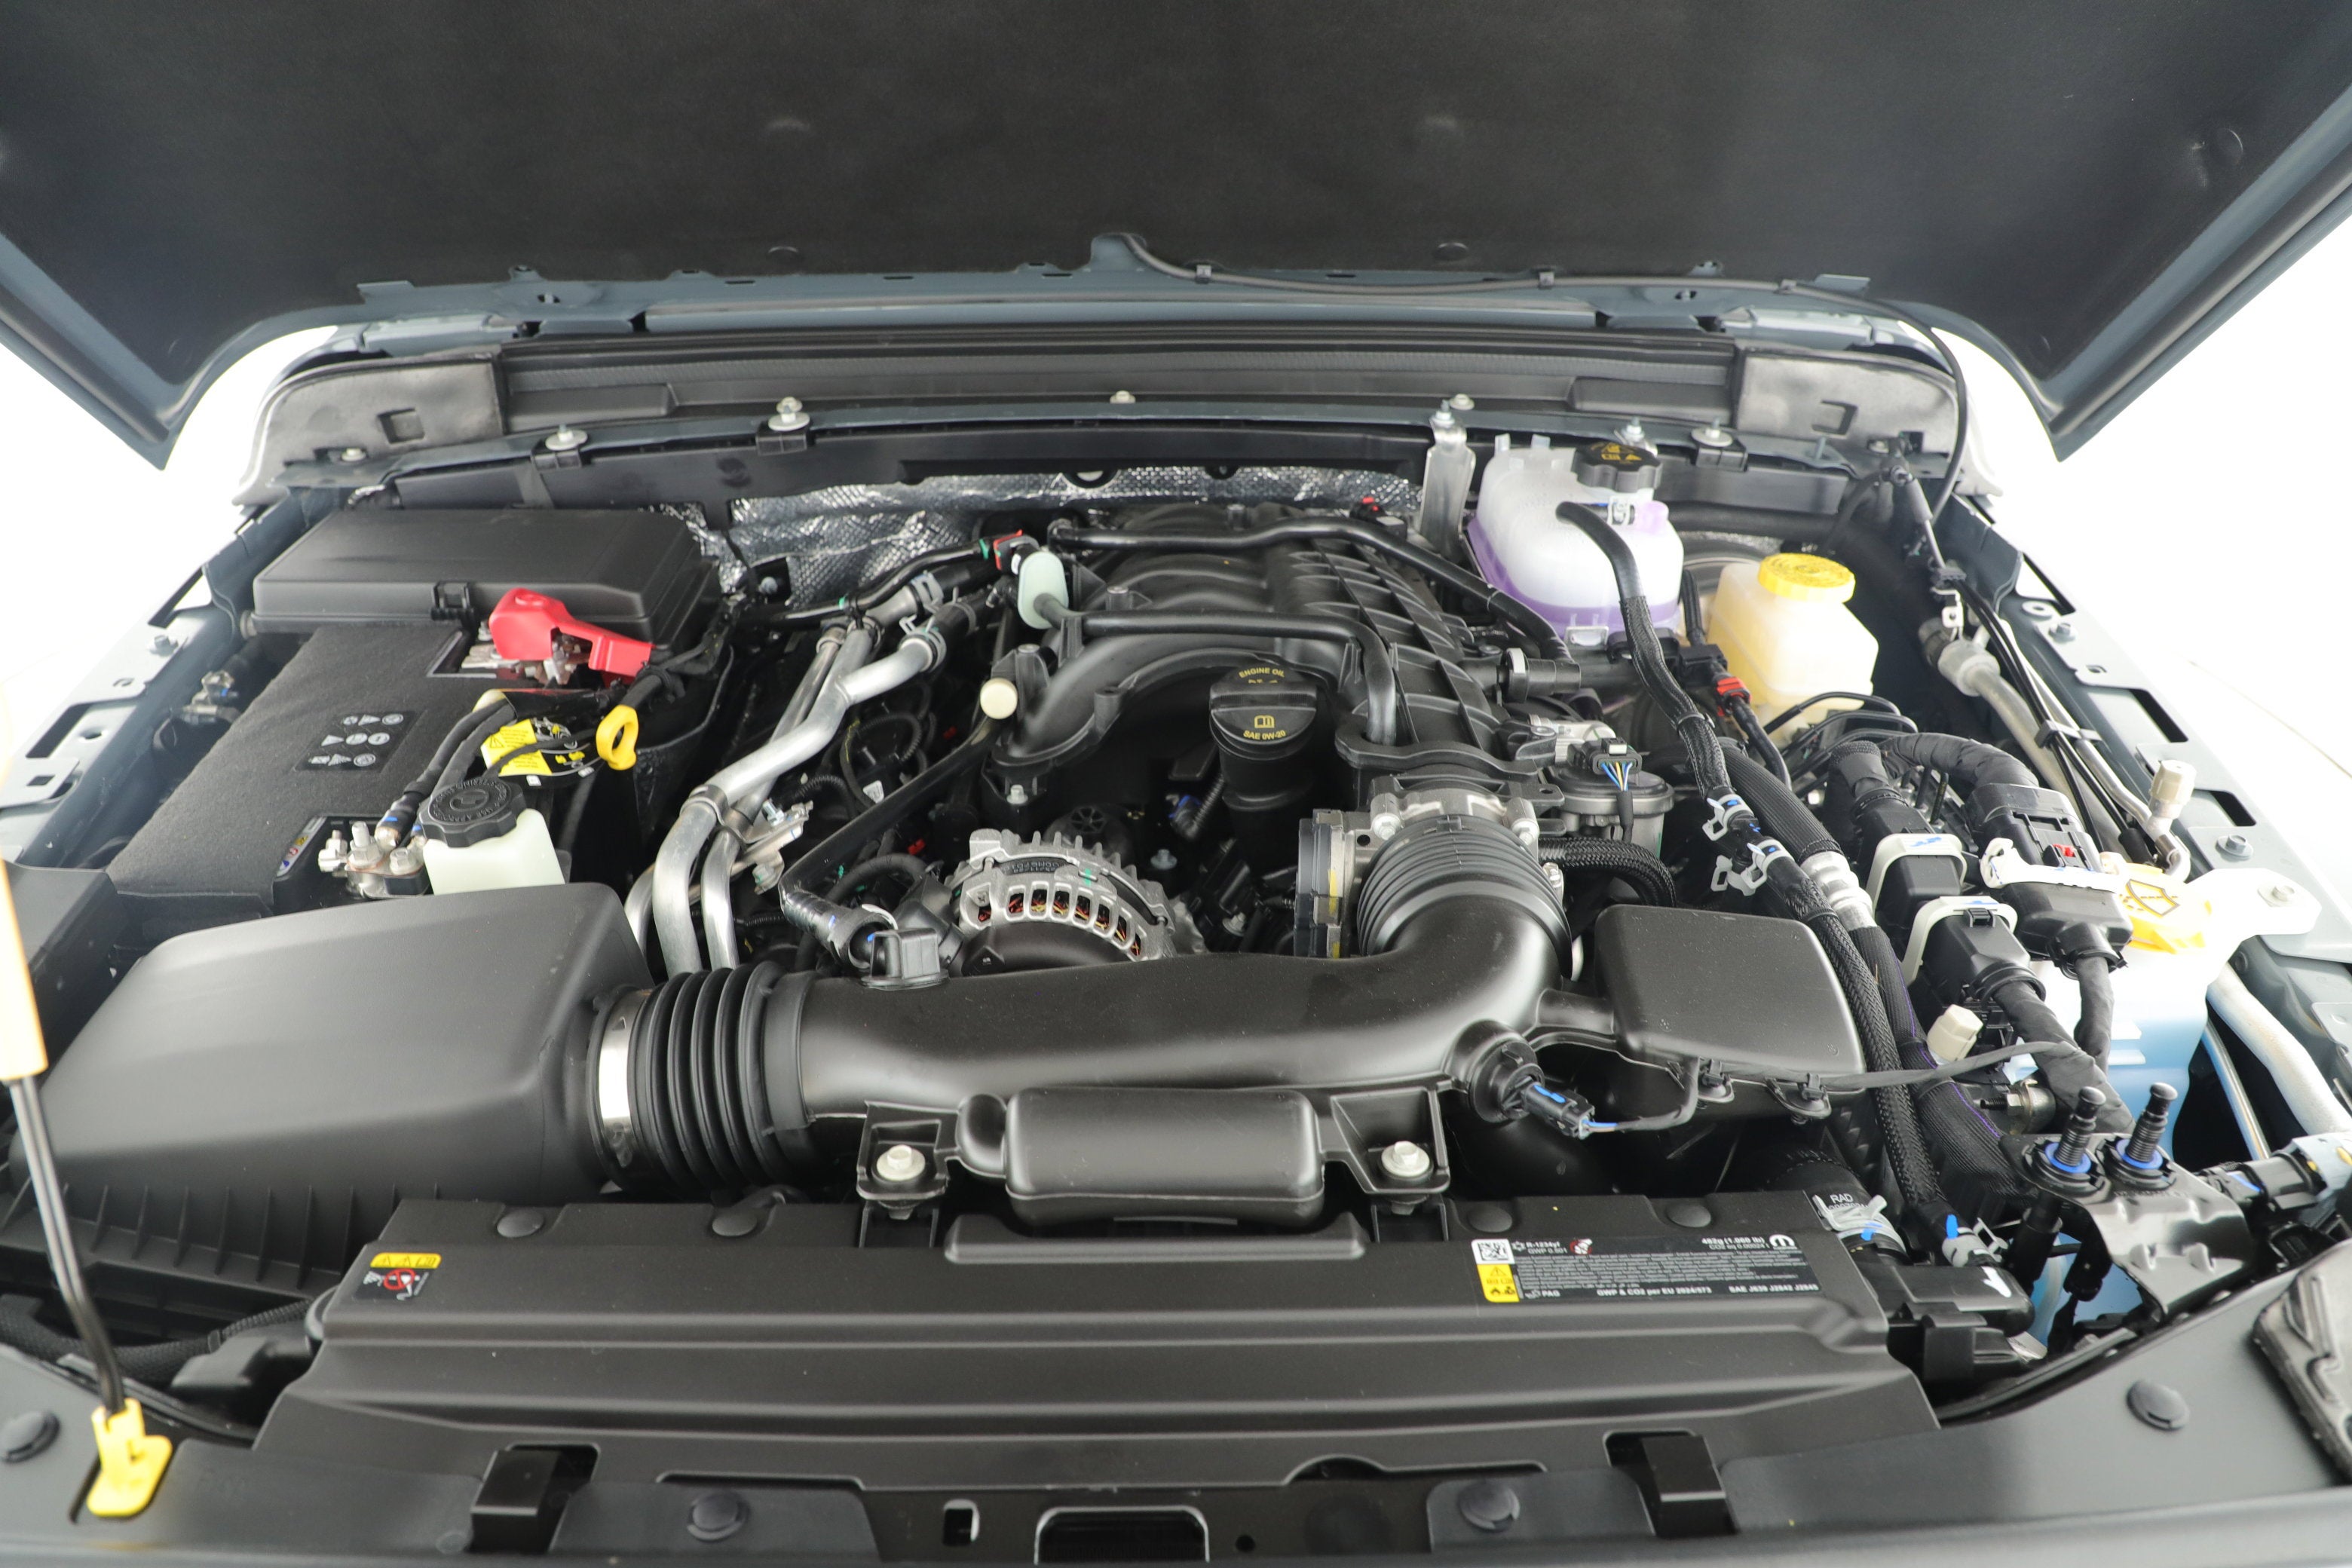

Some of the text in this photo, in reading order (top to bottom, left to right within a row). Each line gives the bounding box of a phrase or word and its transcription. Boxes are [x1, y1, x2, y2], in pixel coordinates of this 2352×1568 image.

[1239, 667, 1285, 678] ENGINE OIL
[1243, 729, 1286, 740] SAE 0W-20
[1830, 1193, 1854, 1204] RAD
[1749, 1285, 1769, 1293] J639
